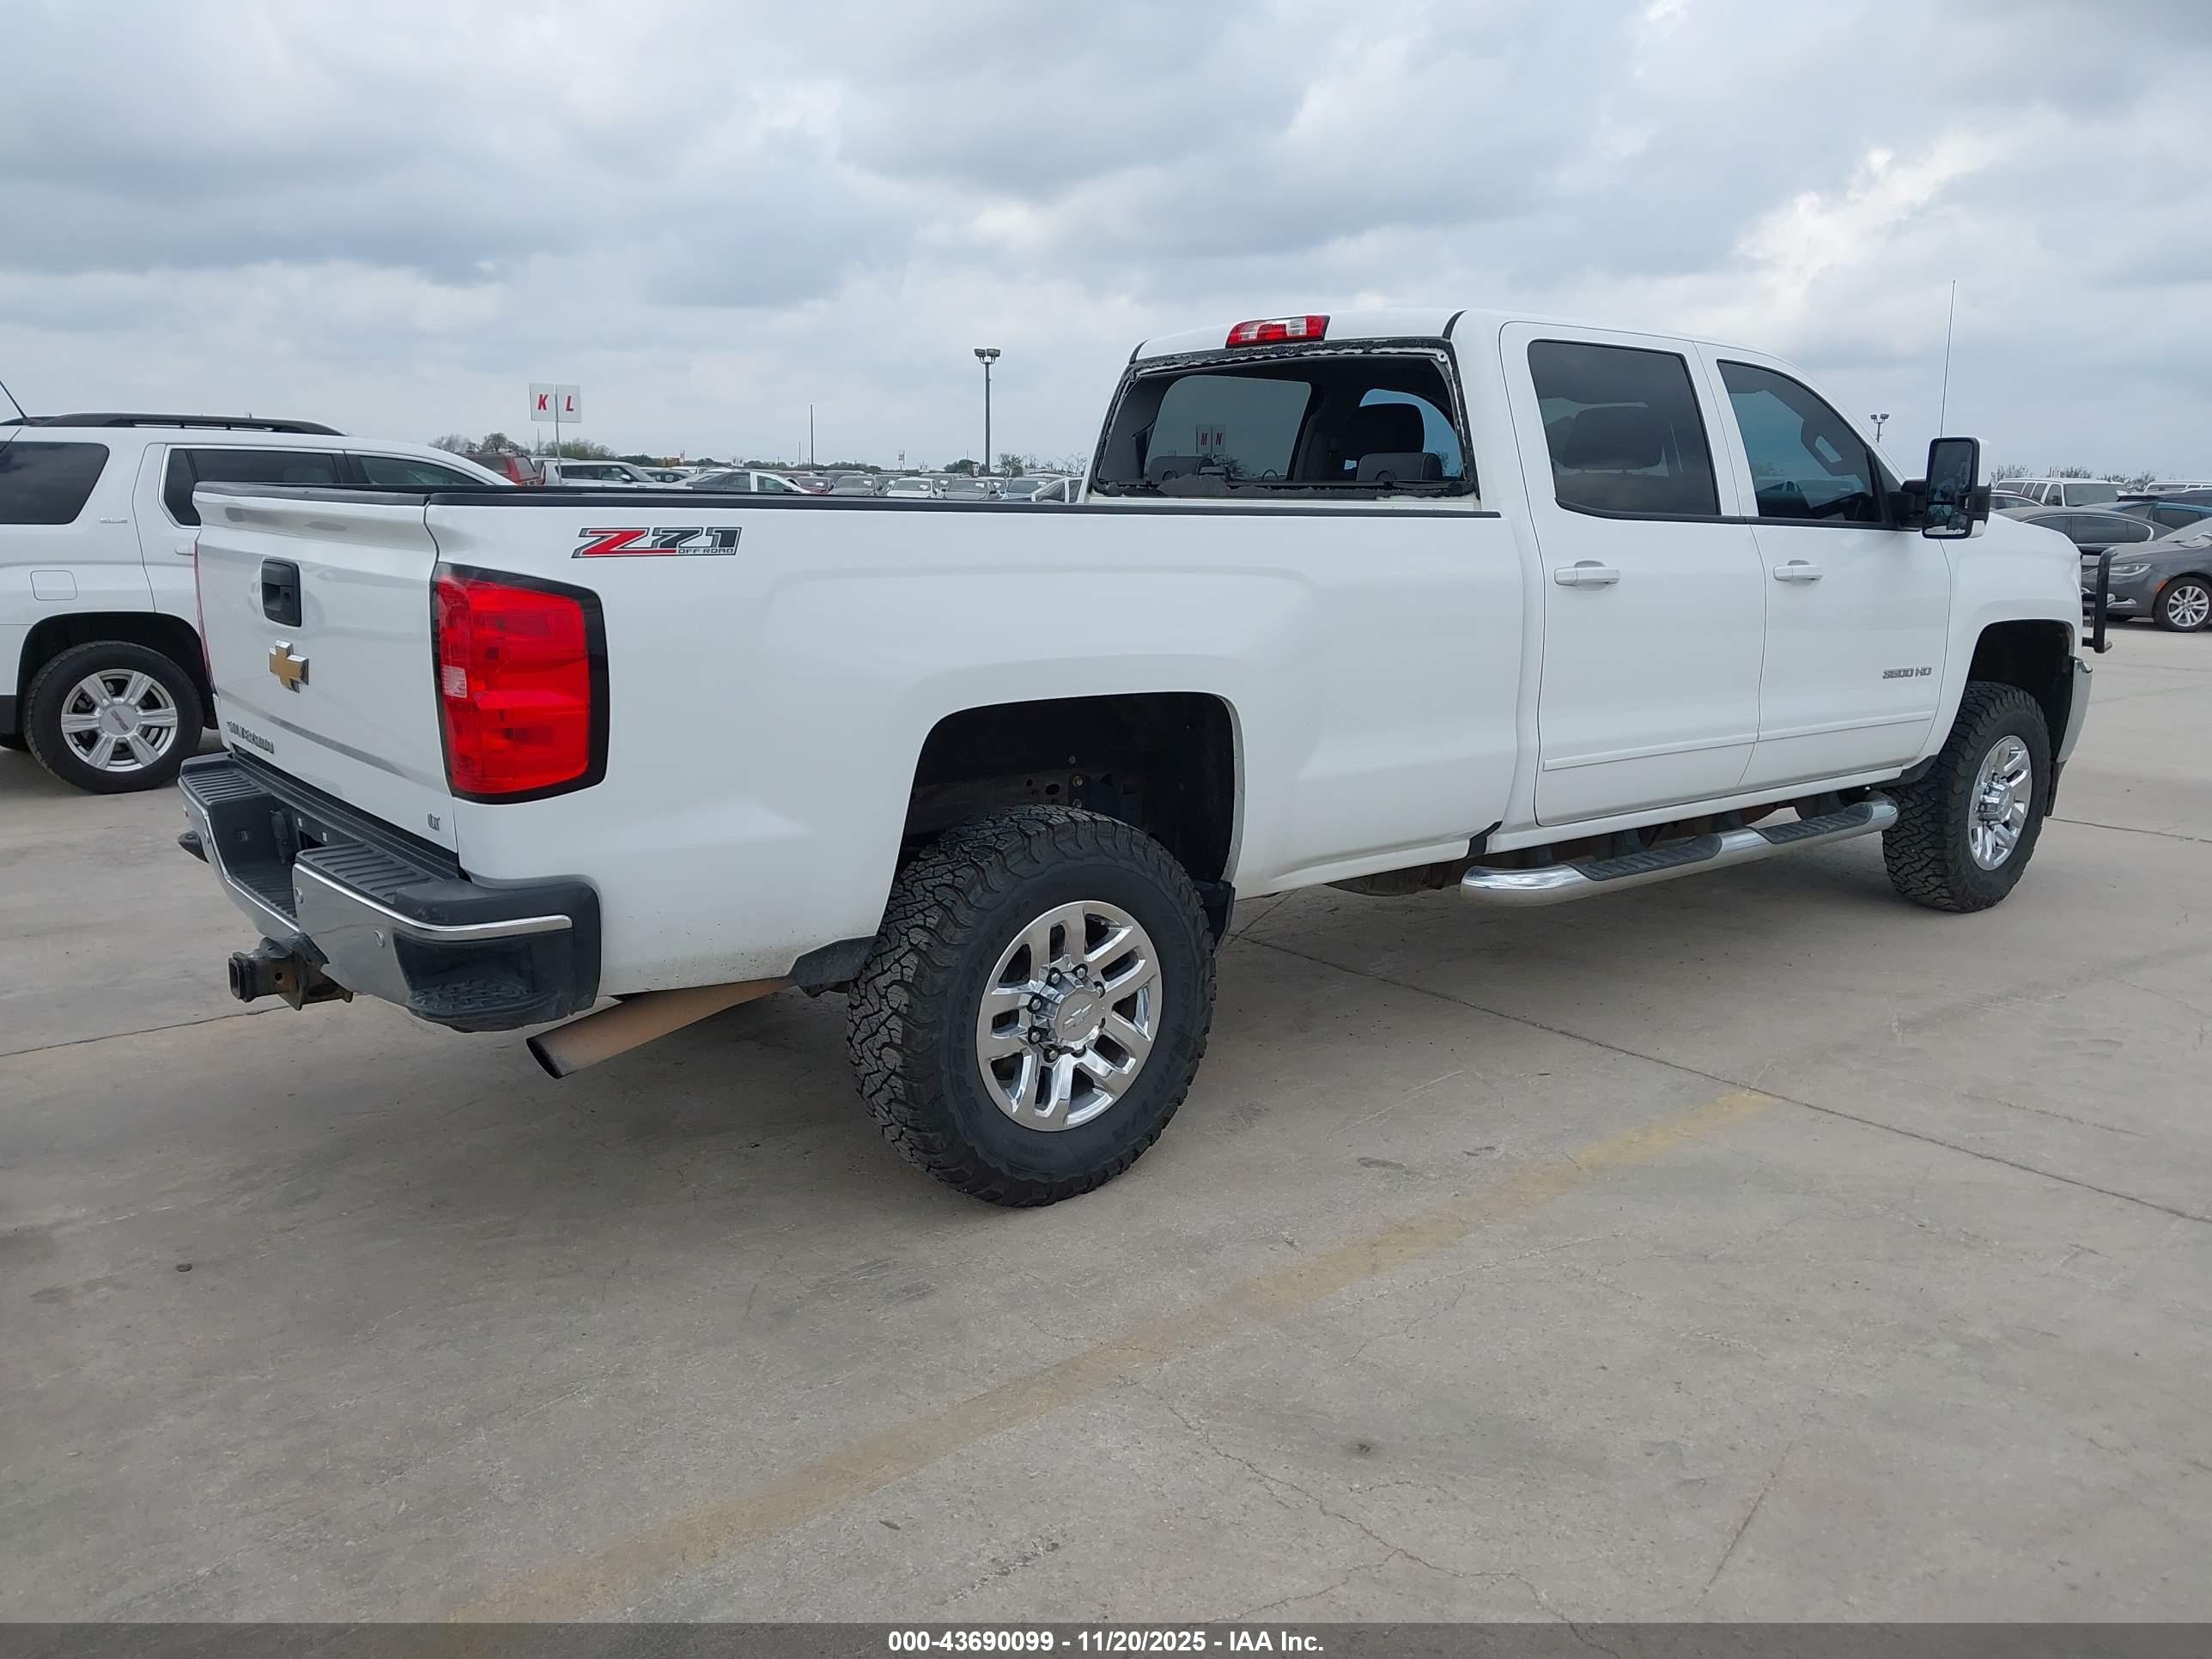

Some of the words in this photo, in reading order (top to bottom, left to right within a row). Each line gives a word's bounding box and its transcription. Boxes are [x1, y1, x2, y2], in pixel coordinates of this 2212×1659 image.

[538, 394, 549, 410] K
[566, 395, 574, 411] L
[1200, 432, 1208, 446] M
[1215, 432, 1223, 446] N
[571, 526, 742, 558] Z71
